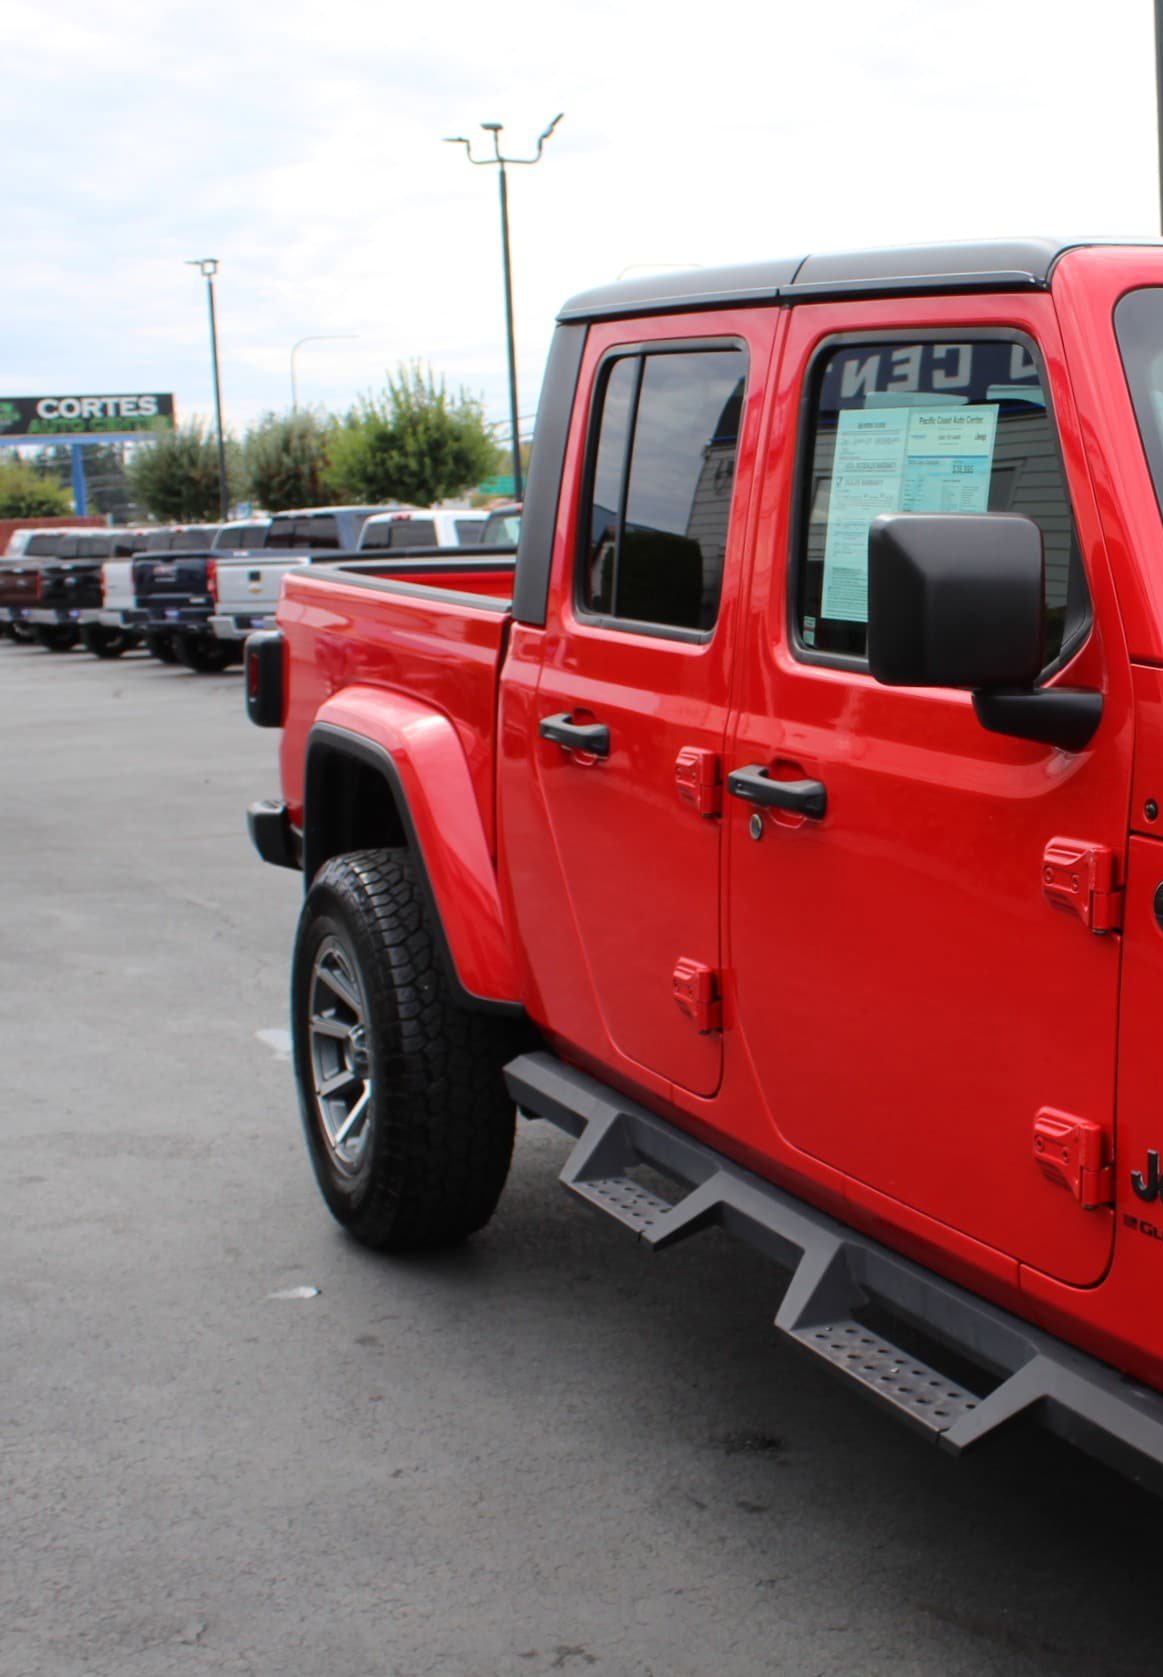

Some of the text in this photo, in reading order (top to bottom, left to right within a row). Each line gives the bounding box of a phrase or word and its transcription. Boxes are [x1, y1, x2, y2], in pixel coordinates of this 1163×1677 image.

[36, 396, 159, 419] CORTES
[27, 418, 85, 434] AUTO
[919, 416, 984, 425] Pacific Coast Auto Center
